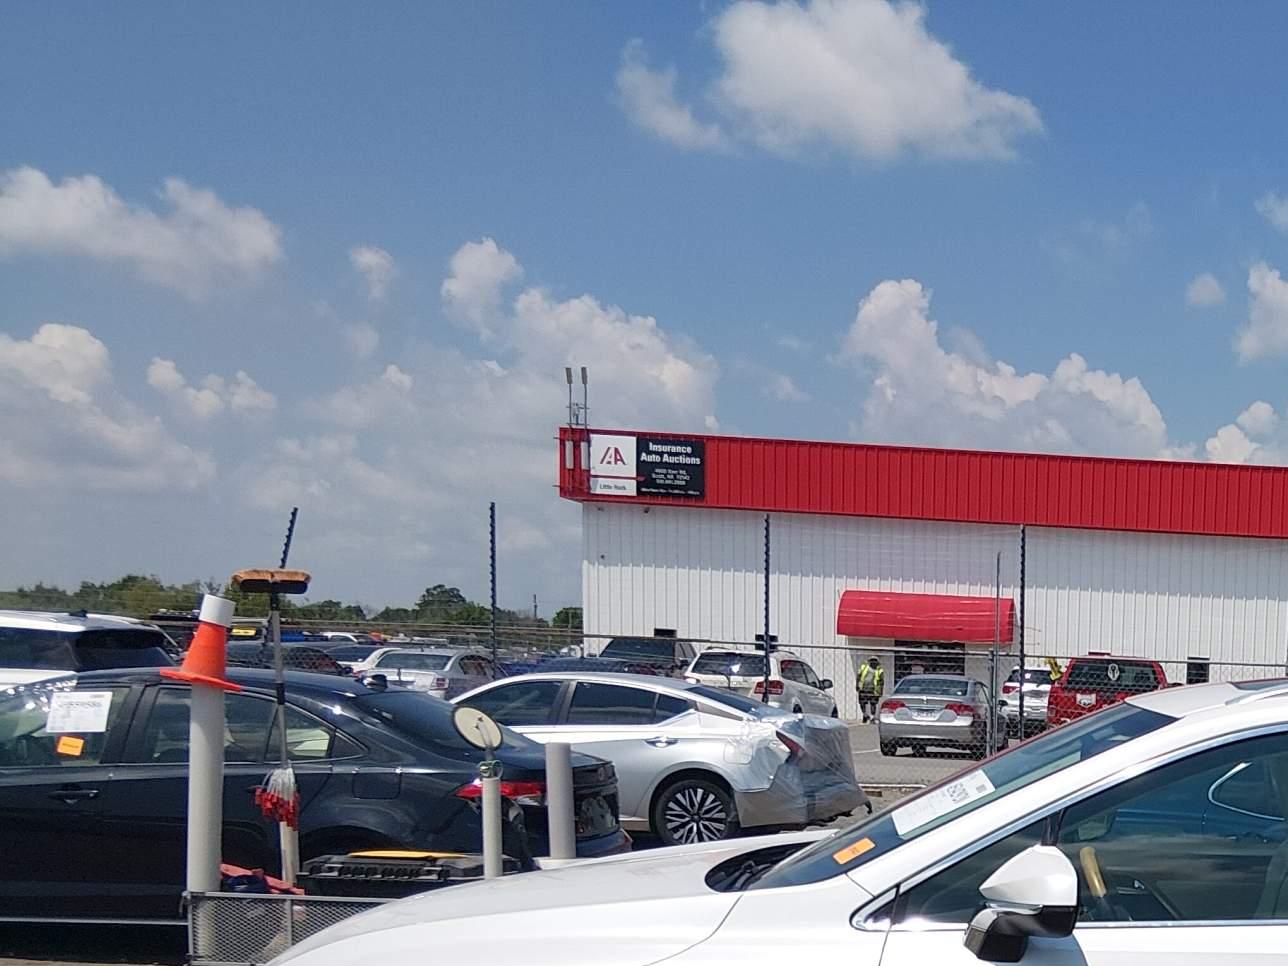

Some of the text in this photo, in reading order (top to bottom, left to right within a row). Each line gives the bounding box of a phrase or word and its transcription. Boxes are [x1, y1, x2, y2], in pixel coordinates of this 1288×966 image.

[649, 442, 692, 454] Insurance
[640, 453, 701, 464] Auto Auctions
